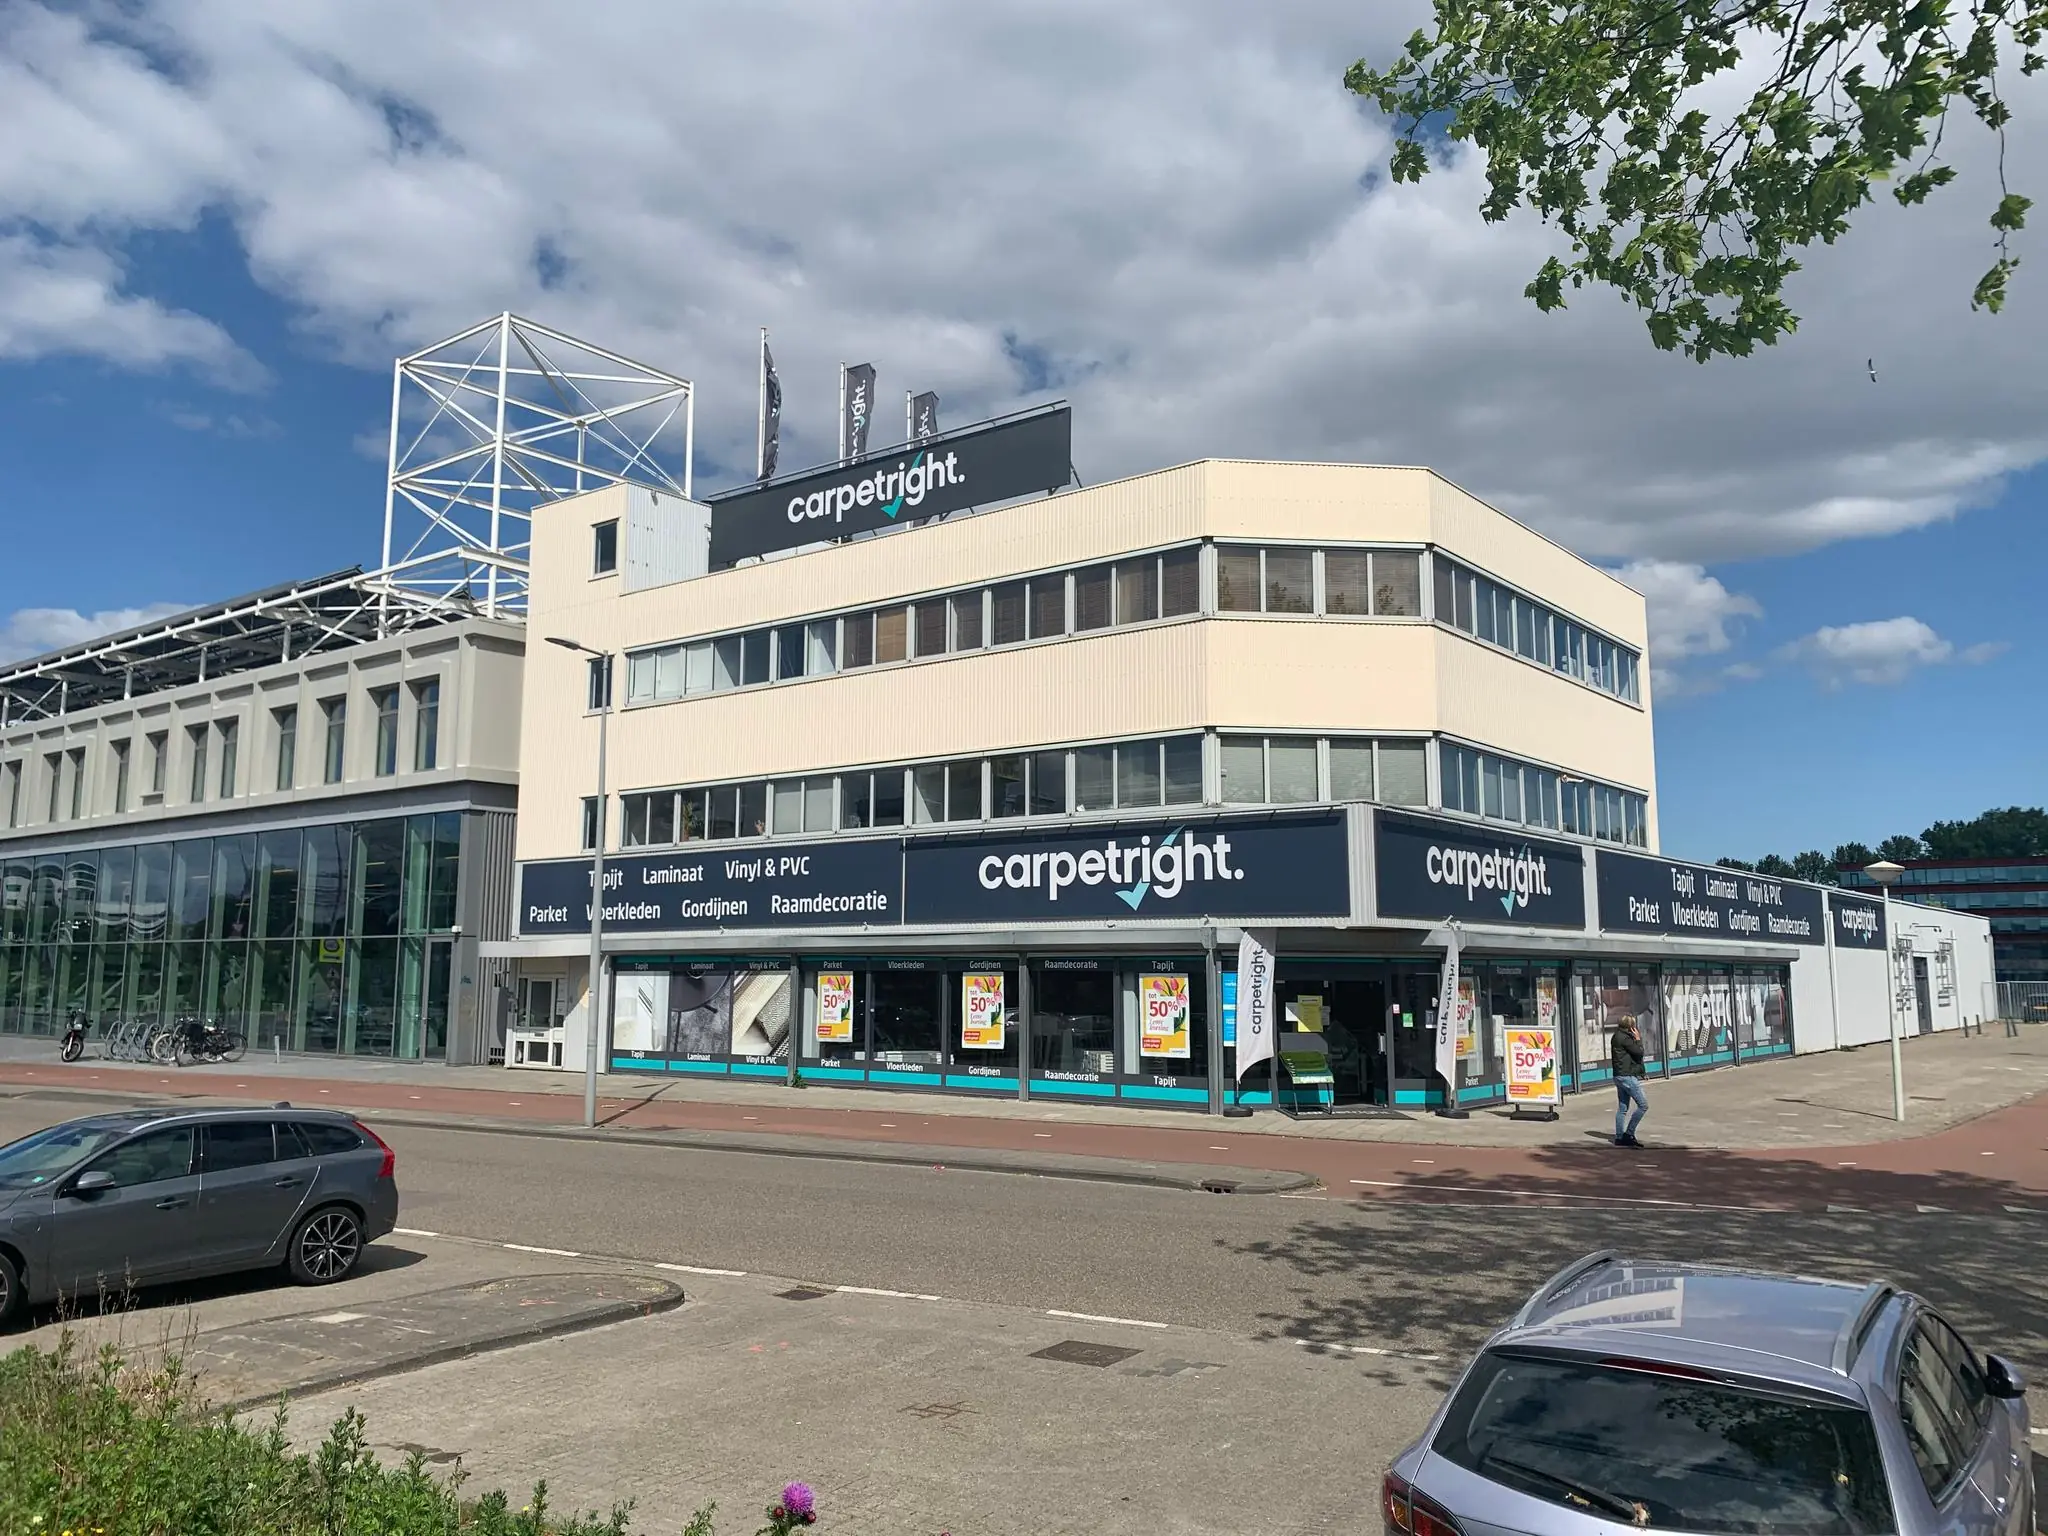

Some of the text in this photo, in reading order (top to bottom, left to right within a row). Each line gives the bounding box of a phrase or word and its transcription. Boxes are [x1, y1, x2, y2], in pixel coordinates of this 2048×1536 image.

[787, 451, 966, 523] carpetright.
[978, 830, 1245, 901] carpetright.
[588, 856, 810, 891] Tpijt Laminaat Vinyl & PVC
[1426, 845, 1552, 907] carpetright.
[1671, 868, 1783, 907] Tapijt Laminaat Vinyl & PVC
[529, 890, 888, 923] Parket Verkleden Gordijnen Raamdecoratie
[1629, 896, 1810, 936] Parket Vloerkleden Gordijnen Raamdecoratie
[823, 961, 842, 969] Parket
[888, 961, 924, 969] Vloerkleden
[970, 961, 1001, 970] Gordijnen
[1045, 960, 1098, 969] Raamdecoratie
[1152, 961, 1174, 971] Tapijt
[970, 997, 996, 1012] 50%
[1149, 1001, 1179, 1017] 50%
[687, 1053, 711, 1061] Laminaat
[746, 1055, 760, 1064] Vinyl
[766, 1056, 777, 1064] PVC
[1515, 1053, 1545, 1067] 50%
[821, 1059, 840, 1067] Parket
[886, 1062, 923, 1072] Vloerkleden
[968, 1066, 1001, 1077] Gordijnen
[1045, 1071, 1099, 1082] Raamdecoratie
[1154, 1076, 1176, 1087] Tapijt
